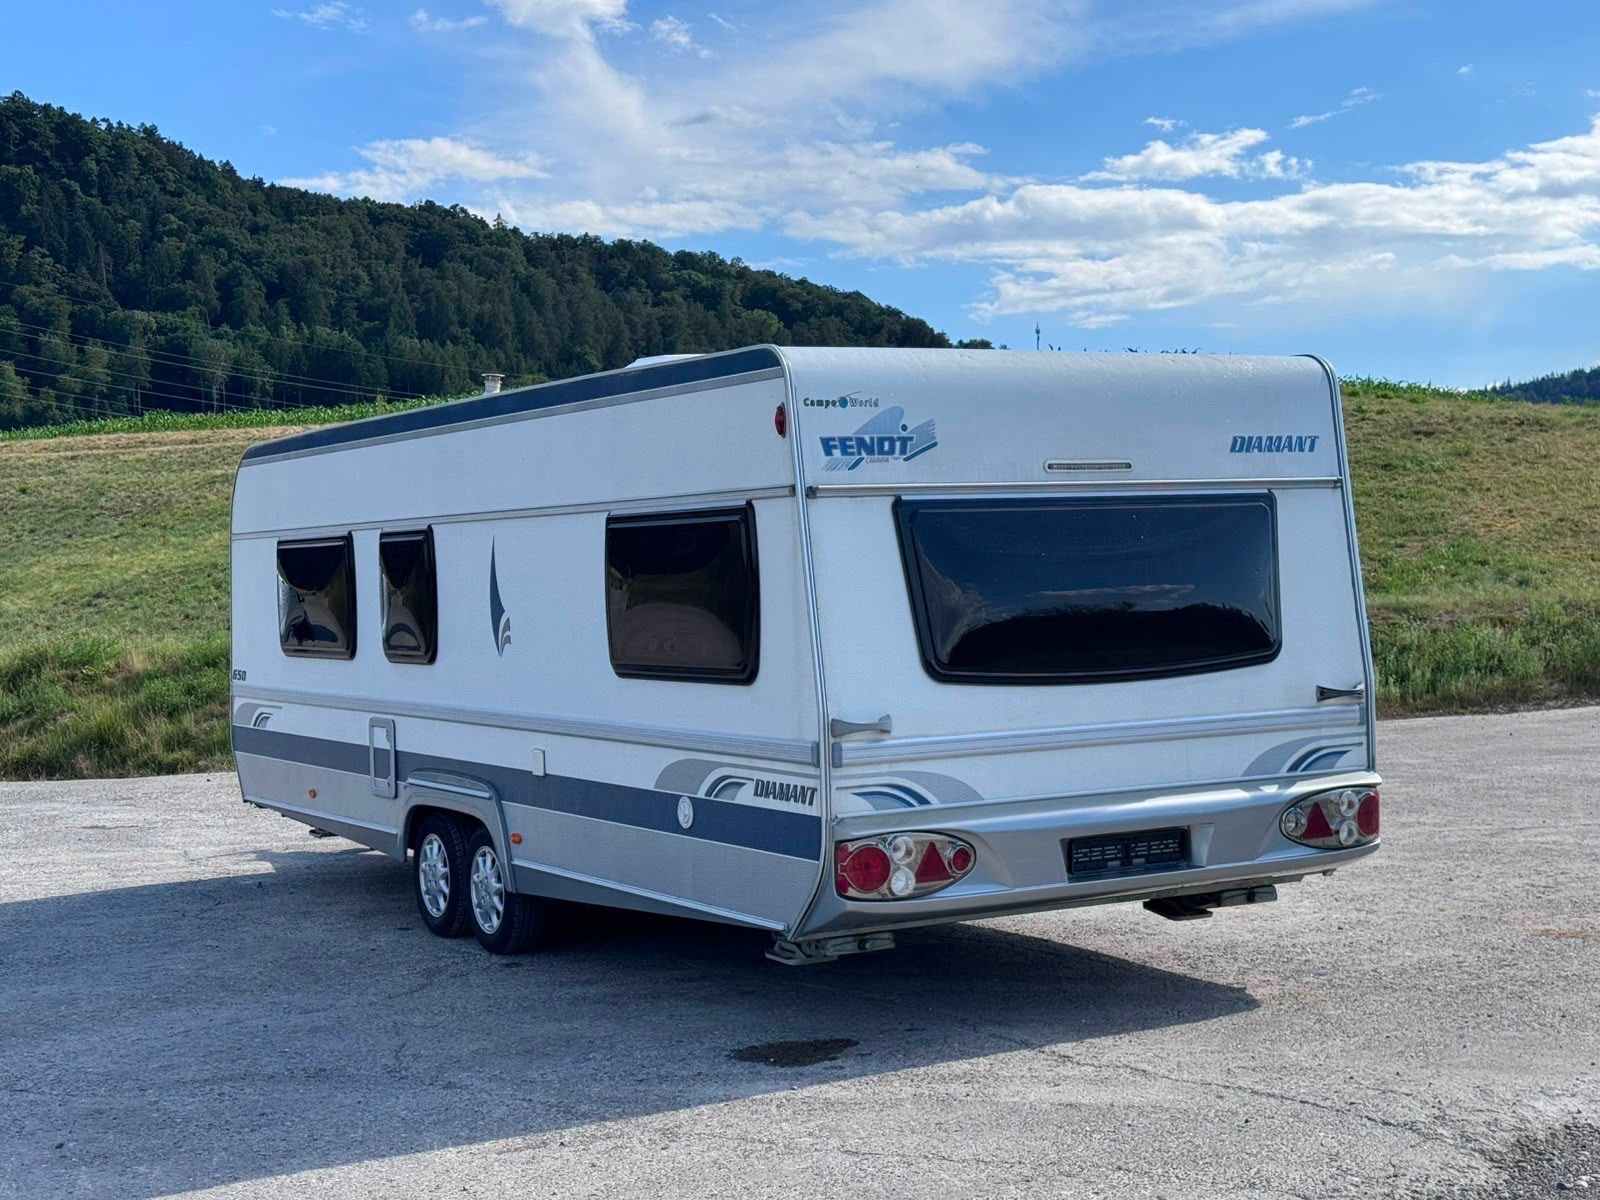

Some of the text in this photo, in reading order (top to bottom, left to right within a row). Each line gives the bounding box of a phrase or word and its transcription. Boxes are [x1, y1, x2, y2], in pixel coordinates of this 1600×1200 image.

[849, 398, 880, 408] World
[819, 435, 915, 457] FENDT
[1229, 434, 1320, 453] DIAMANT
[232, 669, 247, 681] 650
[753, 779, 818, 806] DIAMANT
